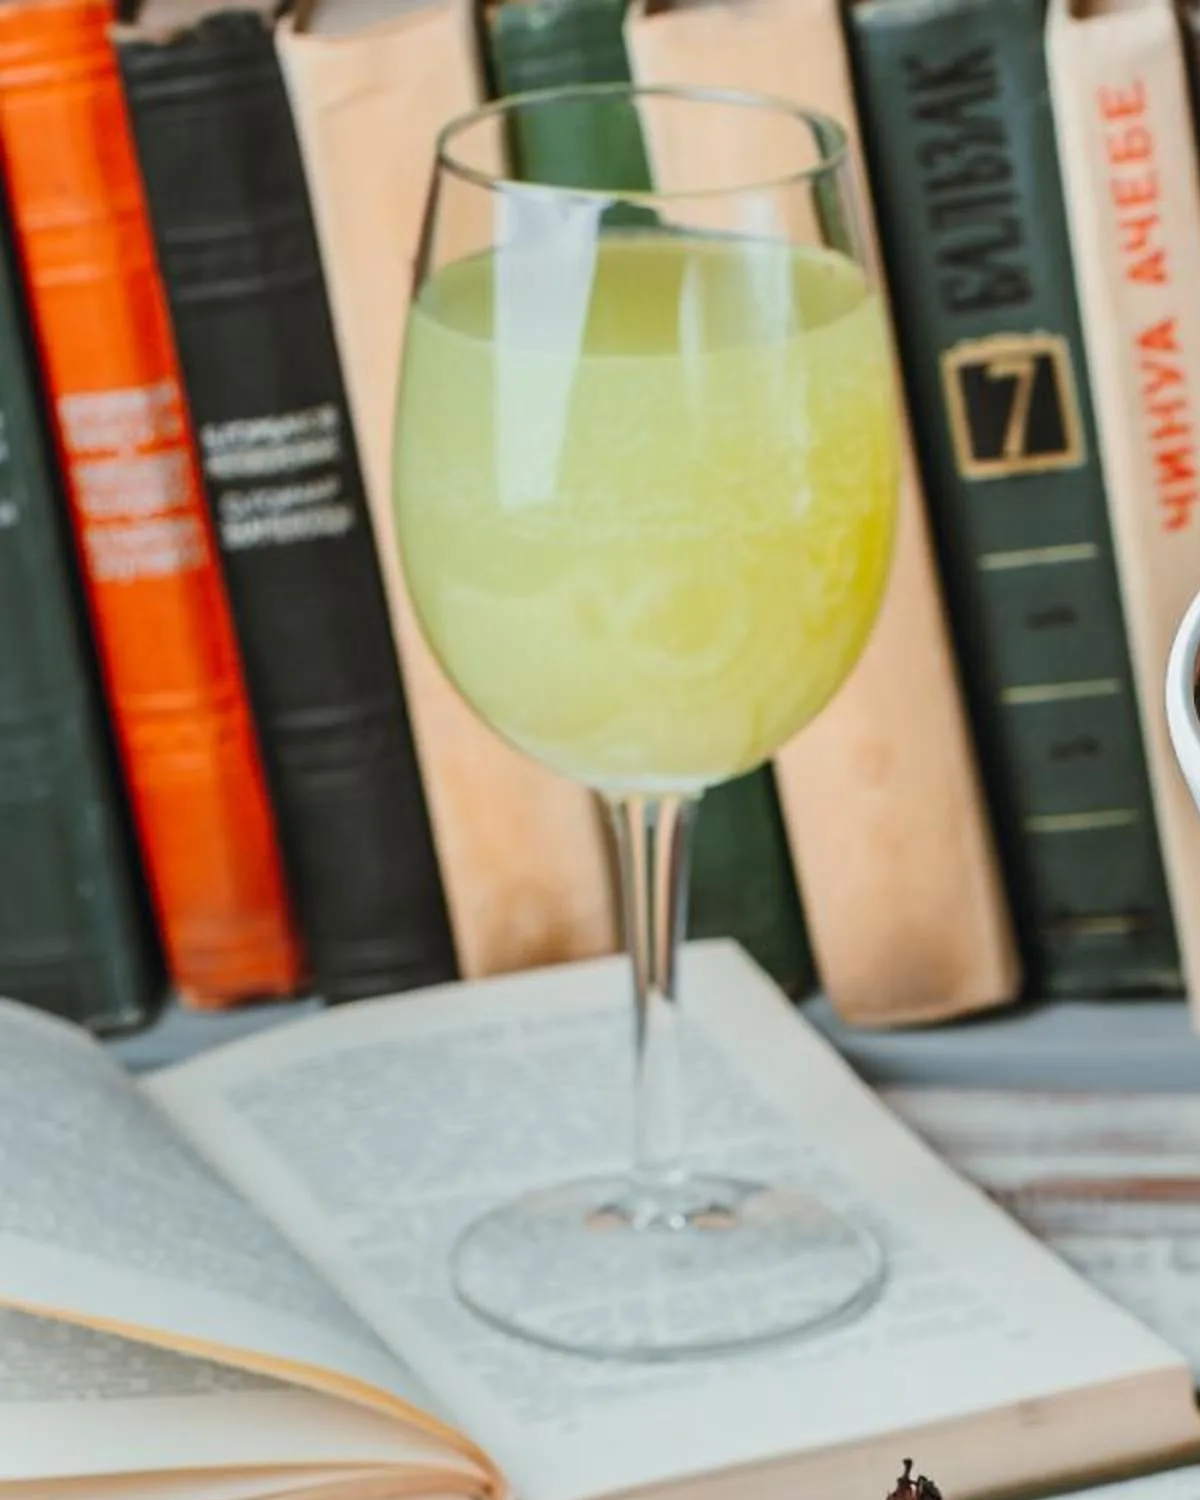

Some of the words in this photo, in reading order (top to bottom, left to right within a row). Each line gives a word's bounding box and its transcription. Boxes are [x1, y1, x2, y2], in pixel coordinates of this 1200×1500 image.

[905, 44, 1034, 313] БАЛЬЗАК
[1098, 78, 1169, 286] АЧЕБЕ
[985, 354, 1035, 458] 7
[1137, 316, 1200, 534] ЧИНУА
